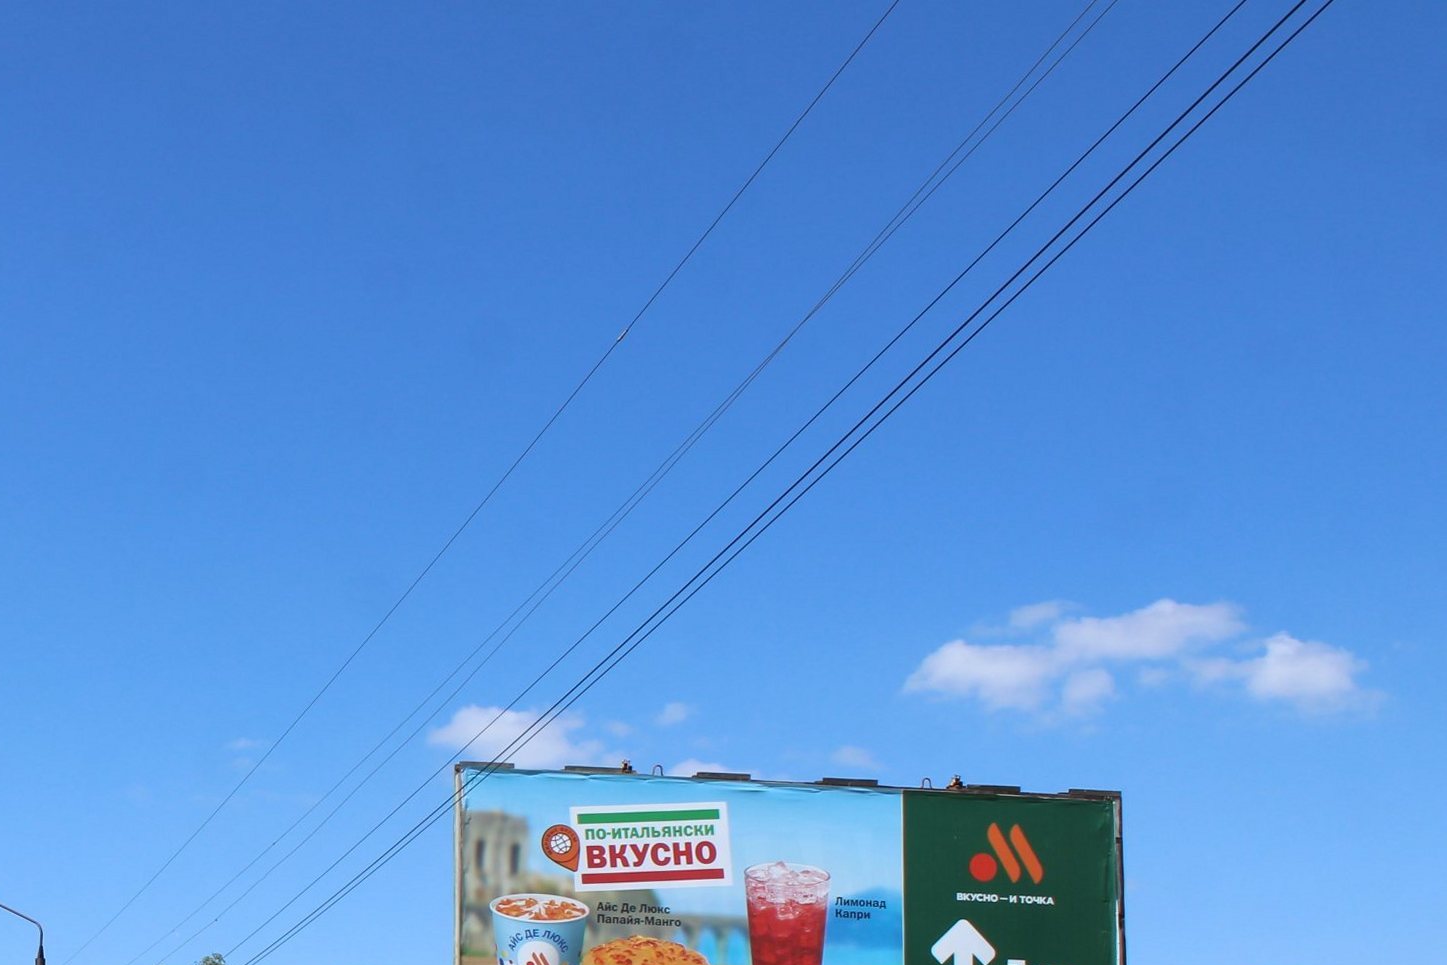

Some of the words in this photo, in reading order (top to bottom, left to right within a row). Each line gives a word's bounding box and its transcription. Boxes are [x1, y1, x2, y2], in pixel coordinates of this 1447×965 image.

[584, 824, 715, 840] ПО-ИТАЛЬЯНСКИ
[585, 840, 717, 868] ВКУСНО
[834, 896, 887, 909] Лимонад
[956, 892, 998, 902] ВКУСНО
[1019, 895, 1055, 905] ТОЧКА
[597, 902, 619, 912] Айс
[621, 902, 637, 914] Де
[639, 903, 671, 915] Люкс
[834, 909, 871, 920] Капри
[597, 914, 682, 927] Папайя-Манго
[508, 931, 524, 951] АЙС
[525, 928, 540, 939] ДЕ
[543, 930, 569, 953] ЛЮКС
